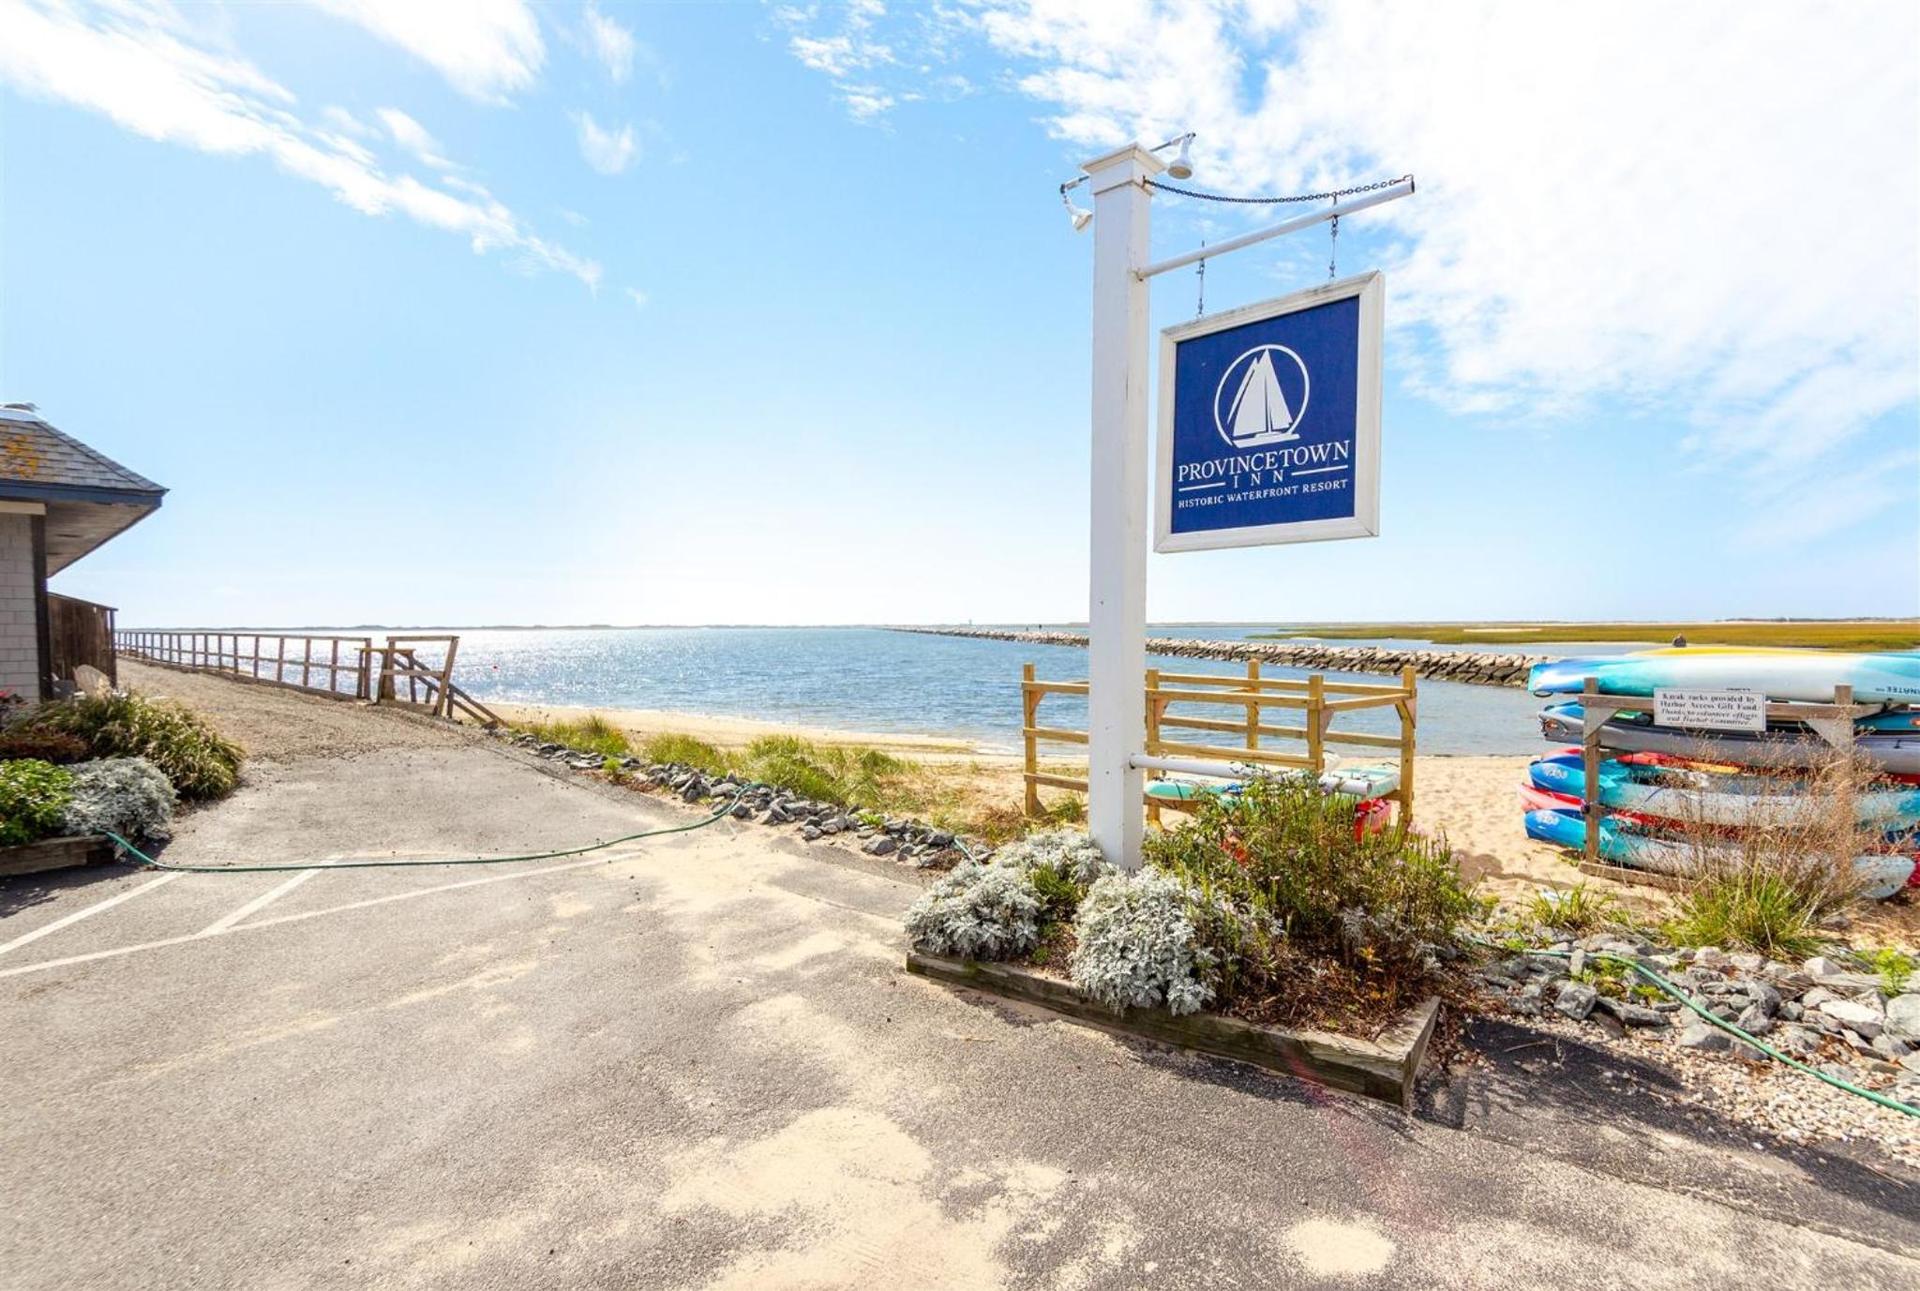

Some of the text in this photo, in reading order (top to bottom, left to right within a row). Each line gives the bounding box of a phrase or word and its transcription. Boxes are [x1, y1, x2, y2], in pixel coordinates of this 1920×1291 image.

[1178, 440, 1350, 482] PROVINCETOWN
[1233, 469, 1284, 489] INN
[1178, 479, 1348, 509] HISTORIC WATERFRONT RESORT
[1662, 693, 1685, 701] Kayak
[1711, 695, 1743, 703] provided
[1746, 696, 1756, 704] by
